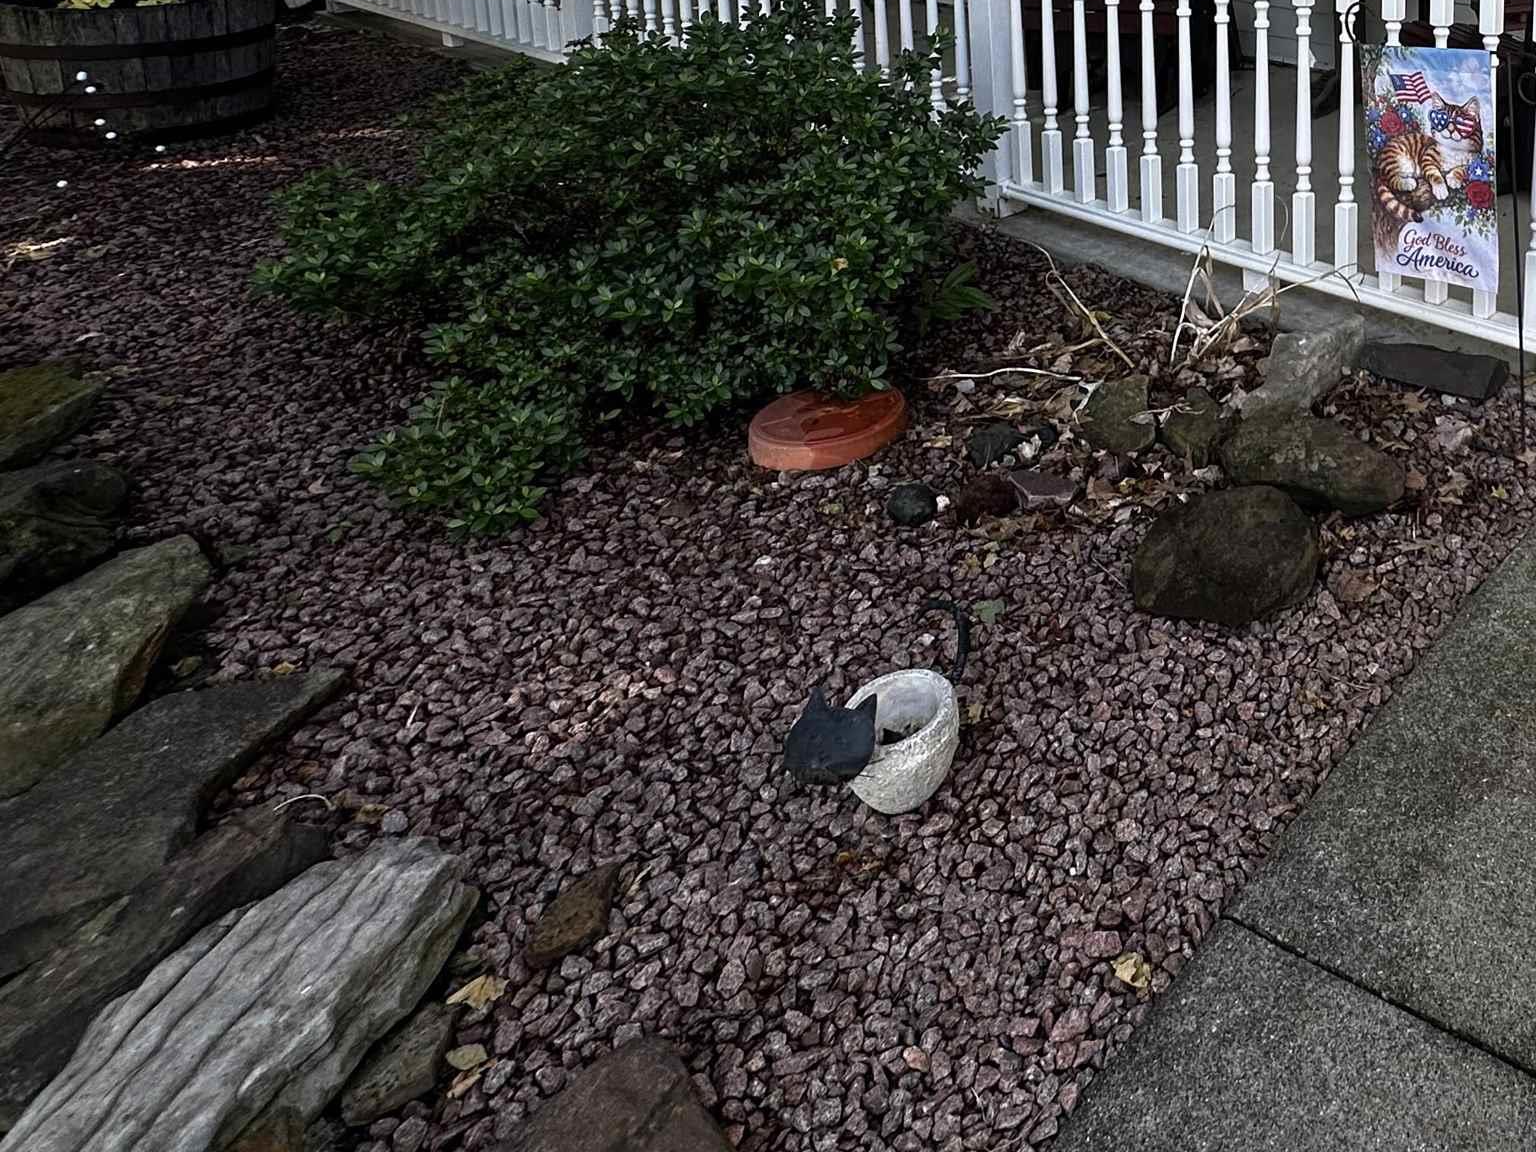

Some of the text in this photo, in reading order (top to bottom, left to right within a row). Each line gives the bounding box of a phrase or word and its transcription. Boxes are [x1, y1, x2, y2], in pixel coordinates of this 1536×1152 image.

[1403, 229, 1466, 257] God Bless
[1396, 247, 1479, 278] America
